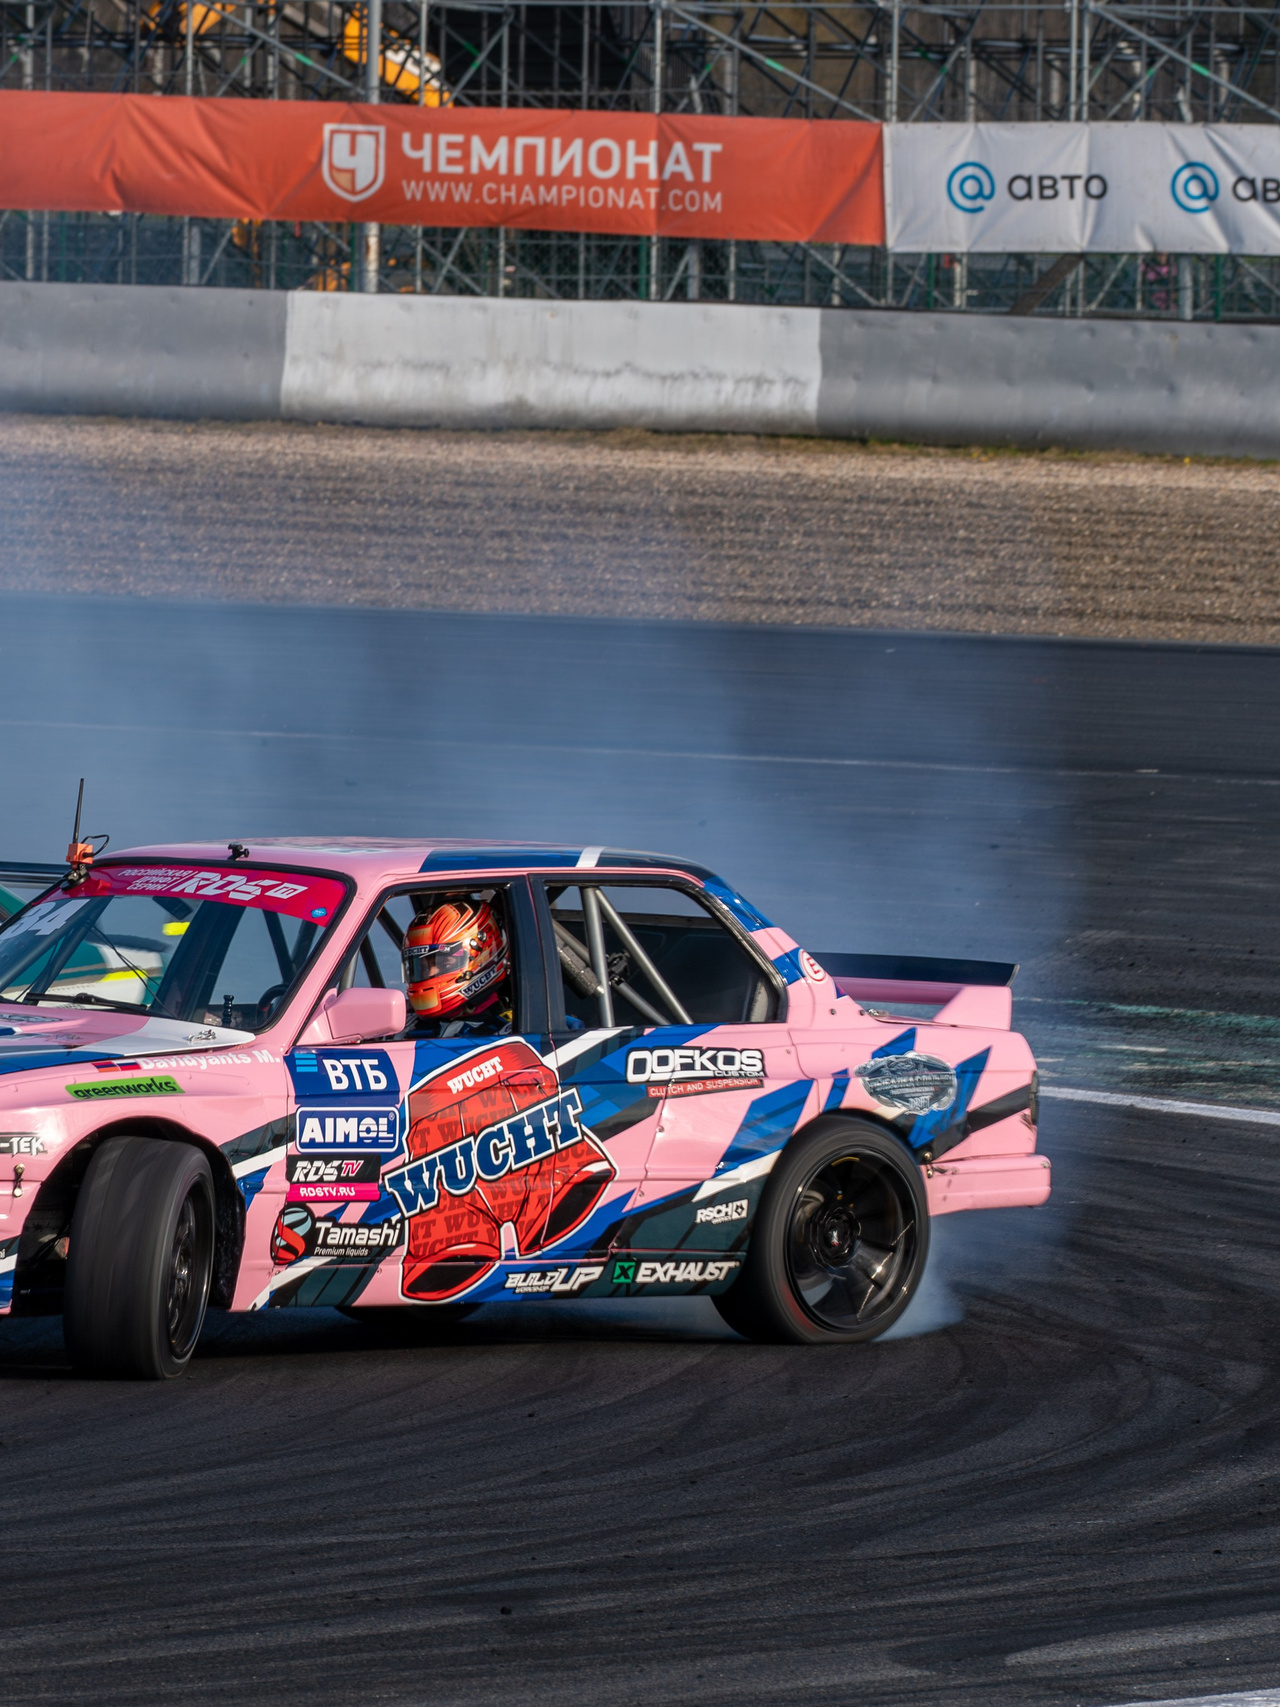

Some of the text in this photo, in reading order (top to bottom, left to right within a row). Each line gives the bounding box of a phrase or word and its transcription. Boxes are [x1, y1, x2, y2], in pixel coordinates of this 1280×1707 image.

[402, 132, 723, 183] ЧЕМПИОНАТ
[402, 180, 722, 213] WWW.CHAMPIONAT.COM
[462, 966, 498, 997] WUCHT
[136, 1049, 281, 1070] Davidyants M.
[322, 1059, 387, 1090] ВТБ
[447, 1056, 503, 1094] WUCHT
[73, 1077, 177, 1099] greenworks
[650, 1079, 759, 1096] CLUTCH AND SUSPENSION
[301, 1117, 394, 1143] AIMOL
[384, 1087, 584, 1218] WUCHT
[300, 1187, 356, 1197] RDSTV.RU
[315, 1221, 401, 1246] Tamashi
[314, 1246, 369, 1257] Premium liquids
[635, 1261, 736, 1283] EXHAUST
